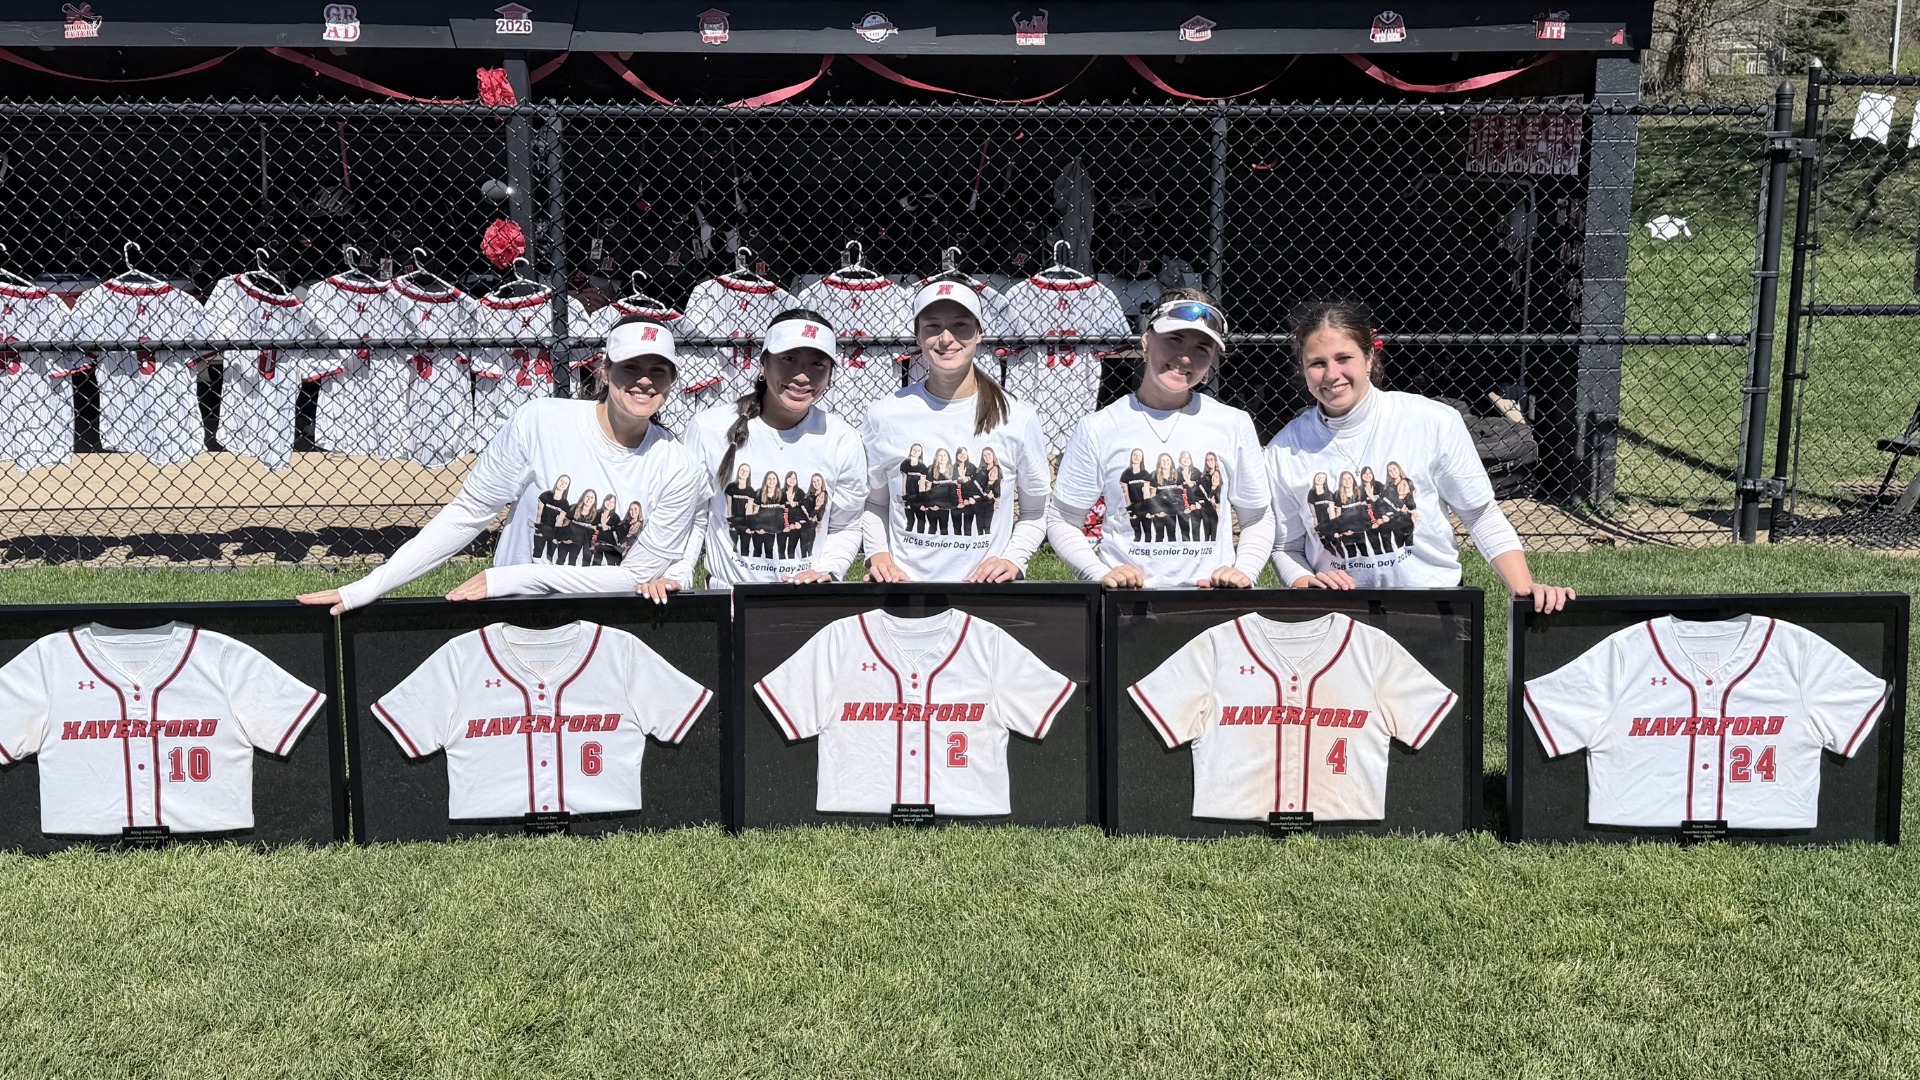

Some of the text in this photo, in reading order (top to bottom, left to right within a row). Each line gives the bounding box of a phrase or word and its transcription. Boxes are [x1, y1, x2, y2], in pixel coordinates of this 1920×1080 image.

[497, 20, 531, 32] 2026
[1546, 26, 1566, 39] IT!
[936, 284, 955, 296] H
[641, 326, 659, 341] H
[801, 323, 820, 340] H
[903, 535, 923, 546] HCSB
[925, 540, 952, 549] Senior
[953, 541, 971, 551] Day
[1128, 547, 1151, 556] HCSB
[1152, 547, 1181, 556] Senior
[1182, 547, 1200, 558] Day
[750, 563, 777, 573] Senior
[779, 565, 796, 574] Day
[1348, 561, 1375, 569] Senior
[1377, 559, 1396, 567] Day
[840, 702, 986, 722] HAVERFORD
[1219, 705, 1370, 729] HAVERFORD
[61, 718, 219, 740] HAVERFORD
[465, 713, 621, 739] HAVERFORD
[1628, 715, 1785, 737] HAVERFORD
[580, 741, 602, 777] 6
[946, 731, 969, 768] 2
[1326, 737, 1348, 775] 4
[168, 746, 211, 783] 10
[1728, 745, 1777, 783] 24
